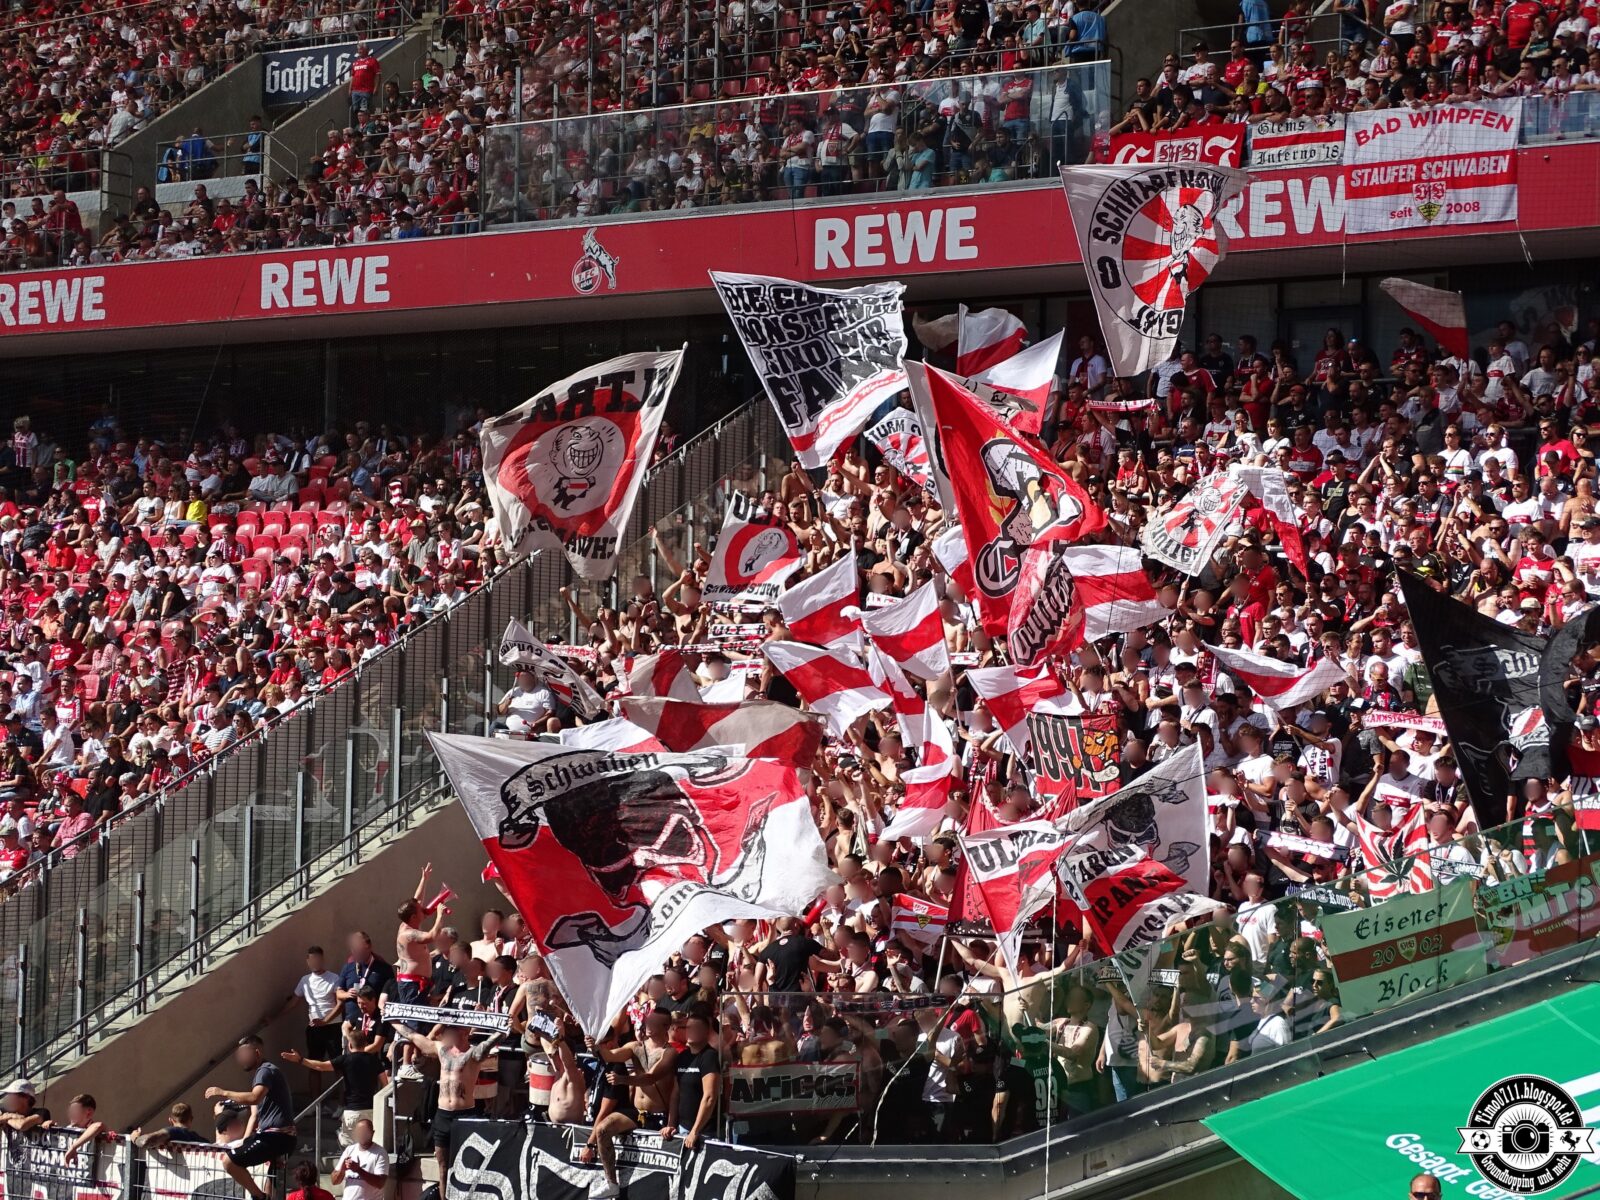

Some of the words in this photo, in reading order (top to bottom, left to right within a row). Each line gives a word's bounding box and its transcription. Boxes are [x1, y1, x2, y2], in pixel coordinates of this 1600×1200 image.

[265, 54, 329, 93] Gaffel
[1257, 119, 1305, 135] Glems
[1355, 117, 1401, 146] BAD
[1408, 108, 1514, 133] WIMPFEN
[1257, 149, 1317, 165] Inferno
[1351, 164, 1417, 188] STAUFER
[1421, 154, 1510, 181] SCHWABEN
[1390, 206, 1413, 220] seit
[1446, 202, 1481, 214] 2008
[814, 206, 978, 270] REWE
[0, 276, 105, 325] REWE
[261, 256, 390, 309] REWE
[527, 751, 661, 801] Schwaben
[1354, 902, 1448, 940] Eisener
[1378, 958, 1448, 1003] Block
[643, 1152, 679, 1170] ULTRAS
